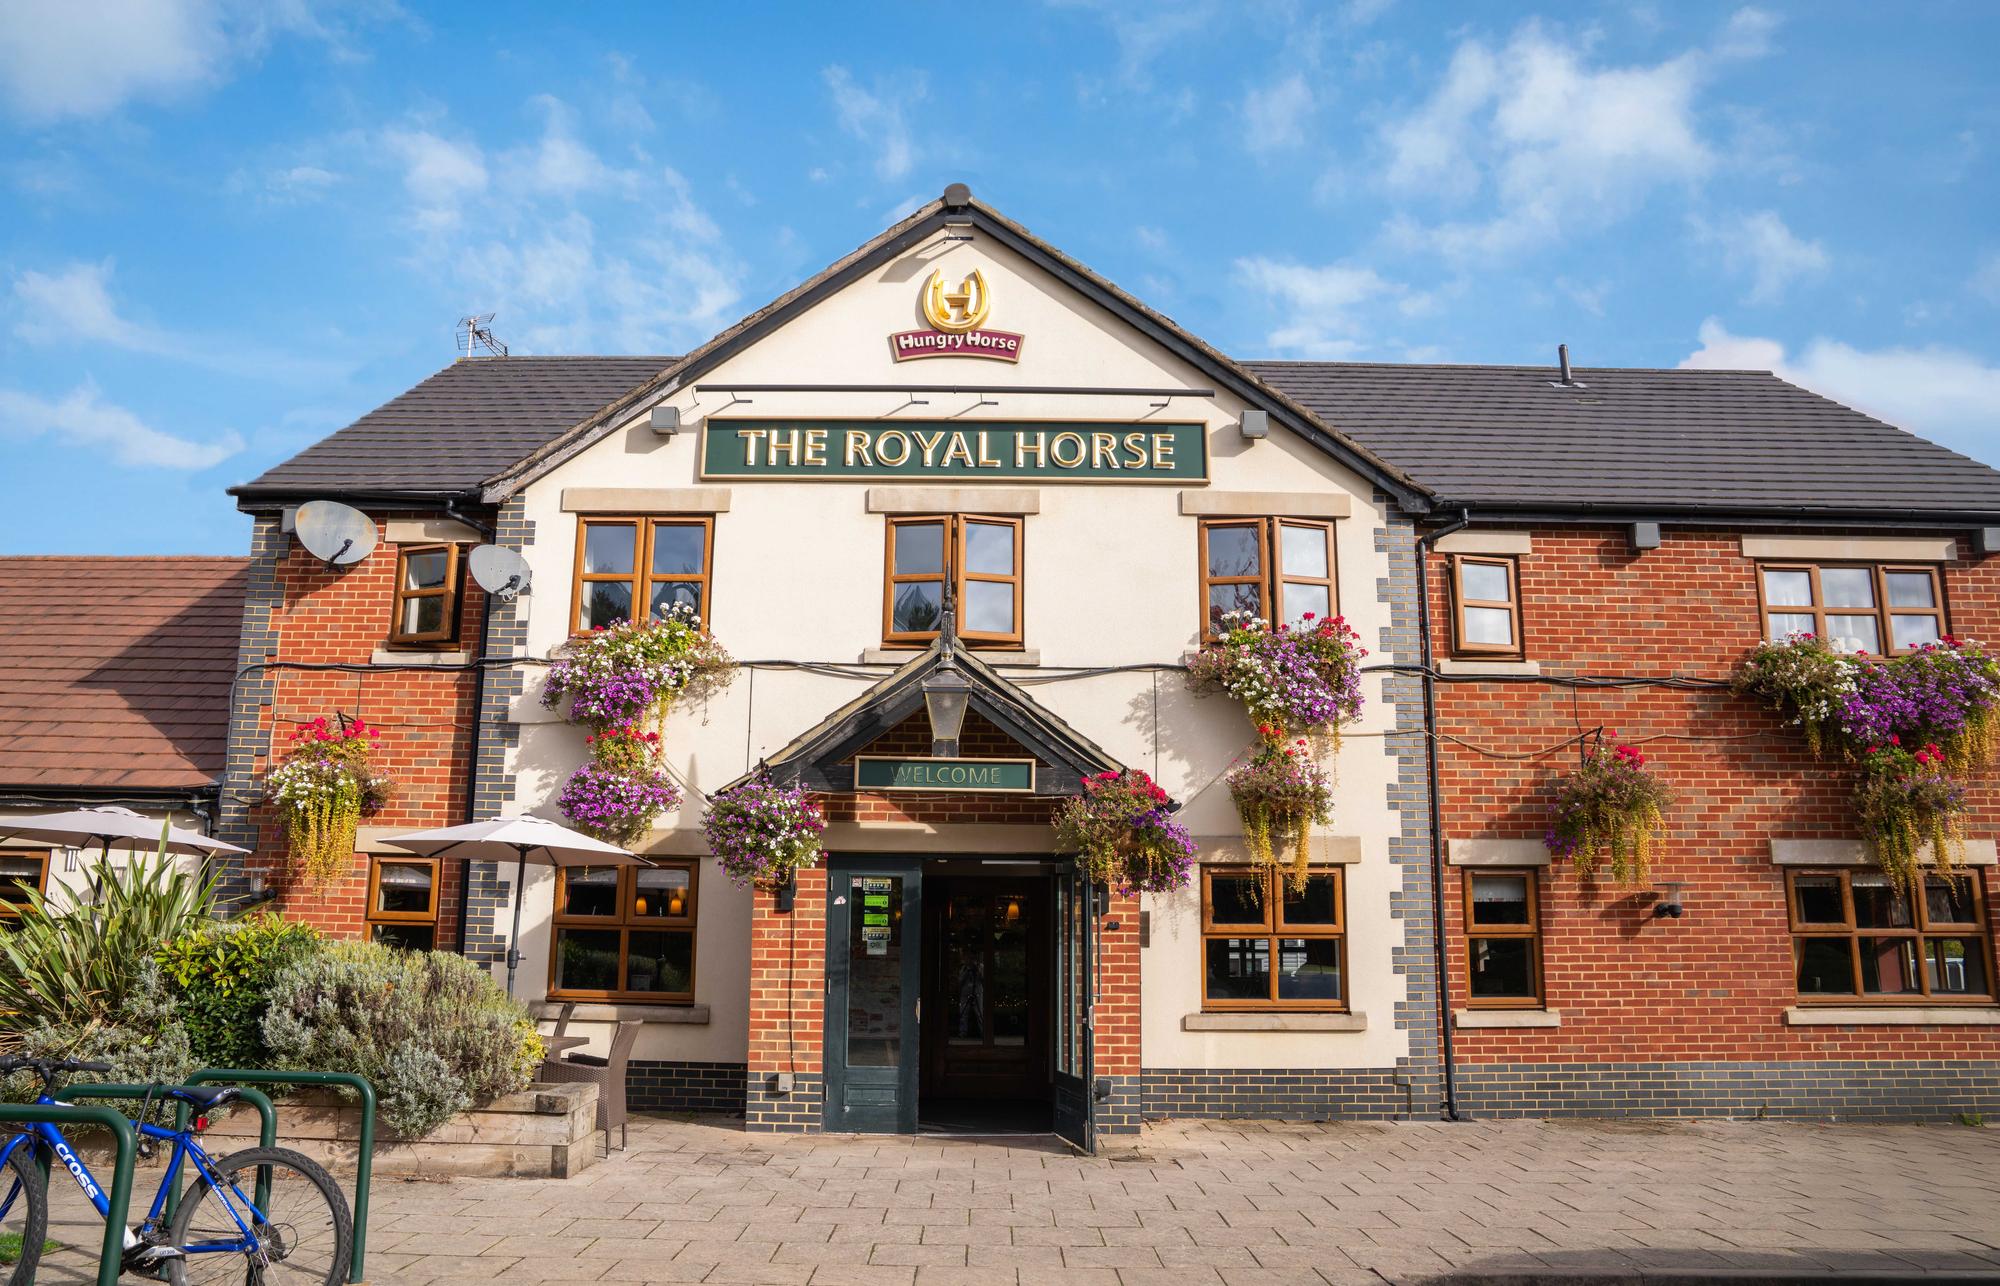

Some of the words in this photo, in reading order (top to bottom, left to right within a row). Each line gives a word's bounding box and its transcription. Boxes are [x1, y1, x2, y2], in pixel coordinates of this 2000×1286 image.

[899, 334, 964, 350] Hungry
[966, 331, 1017, 350] Horse
[737, 429, 828, 466] THE
[844, 430, 1001, 468] ROYAL
[1015, 431, 1176, 470] HORSE
[890, 766, 1001, 784] WELCOME
[55, 1142, 99, 1199] cross
